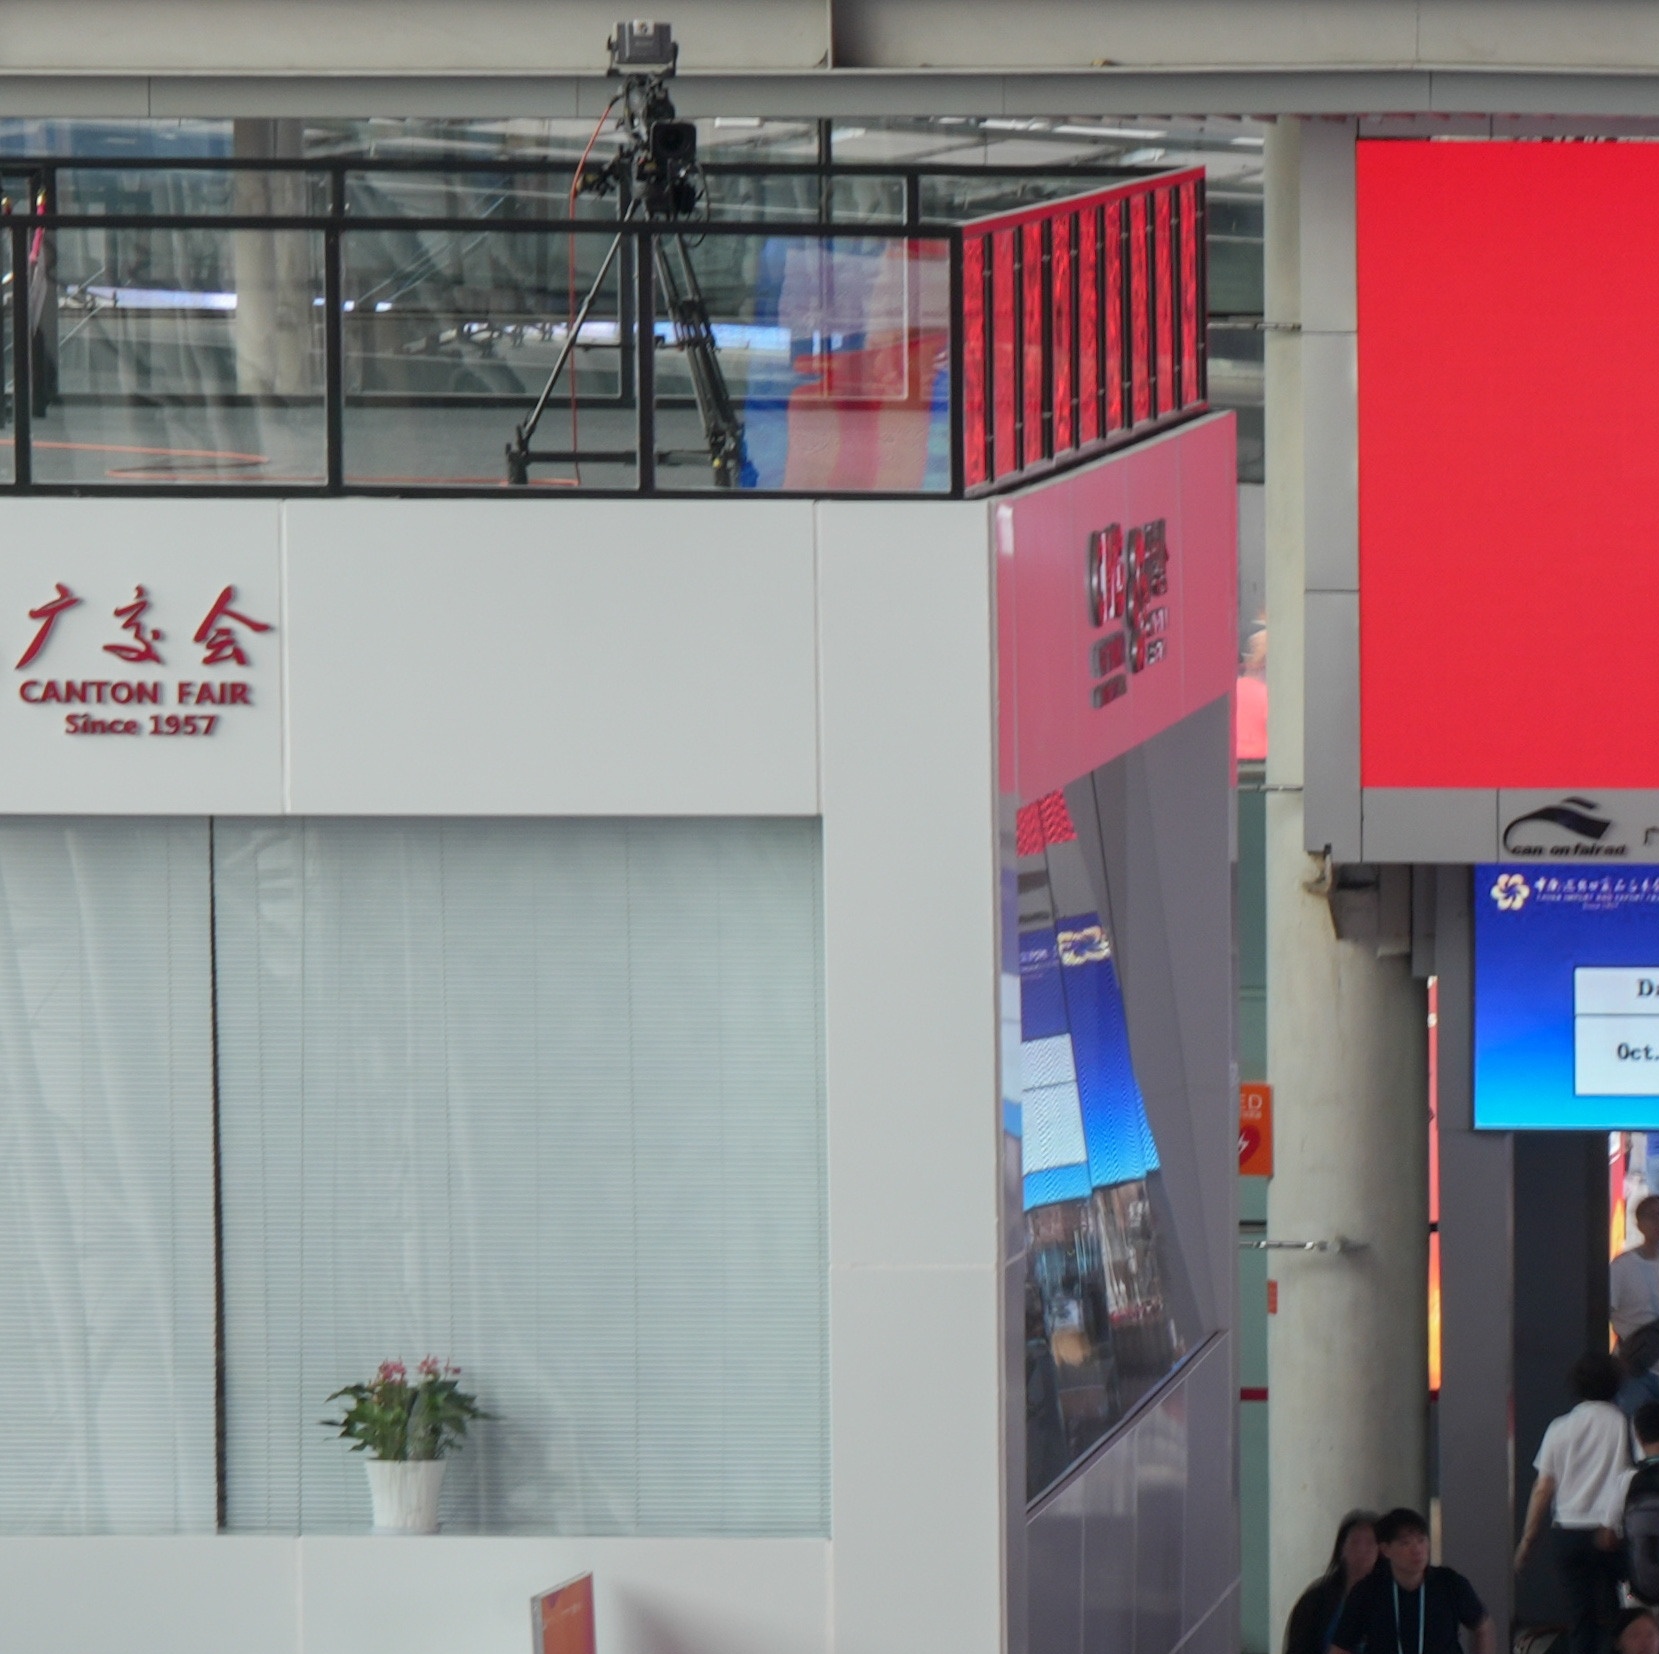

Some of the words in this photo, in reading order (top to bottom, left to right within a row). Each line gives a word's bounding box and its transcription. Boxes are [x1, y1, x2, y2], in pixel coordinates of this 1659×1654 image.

[16, 582, 272, 669] 广交会
[20, 680, 160, 704] CANTON
[178, 682, 250, 704] FAIR
[65, 713, 139, 735] Since
[150, 714, 217, 735] 1957
